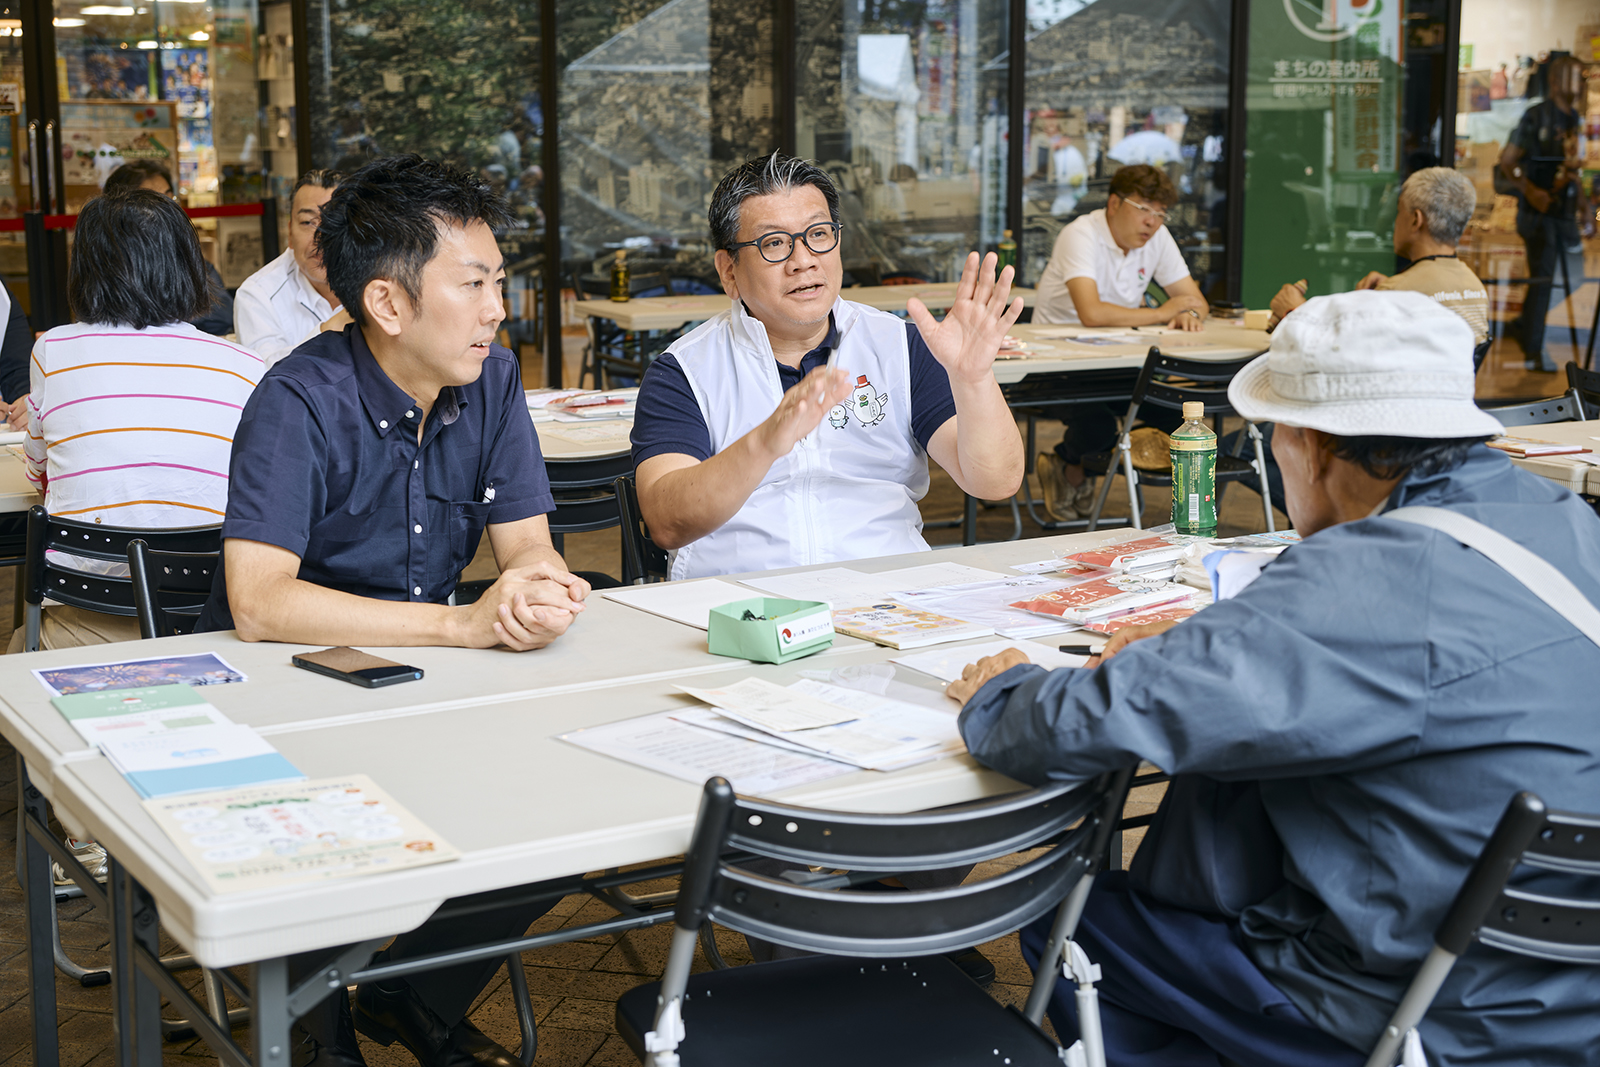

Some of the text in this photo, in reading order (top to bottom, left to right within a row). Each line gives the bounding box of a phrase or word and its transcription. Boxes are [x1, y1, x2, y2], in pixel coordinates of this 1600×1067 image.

[1273, 59, 1380, 78] まちの案内所
